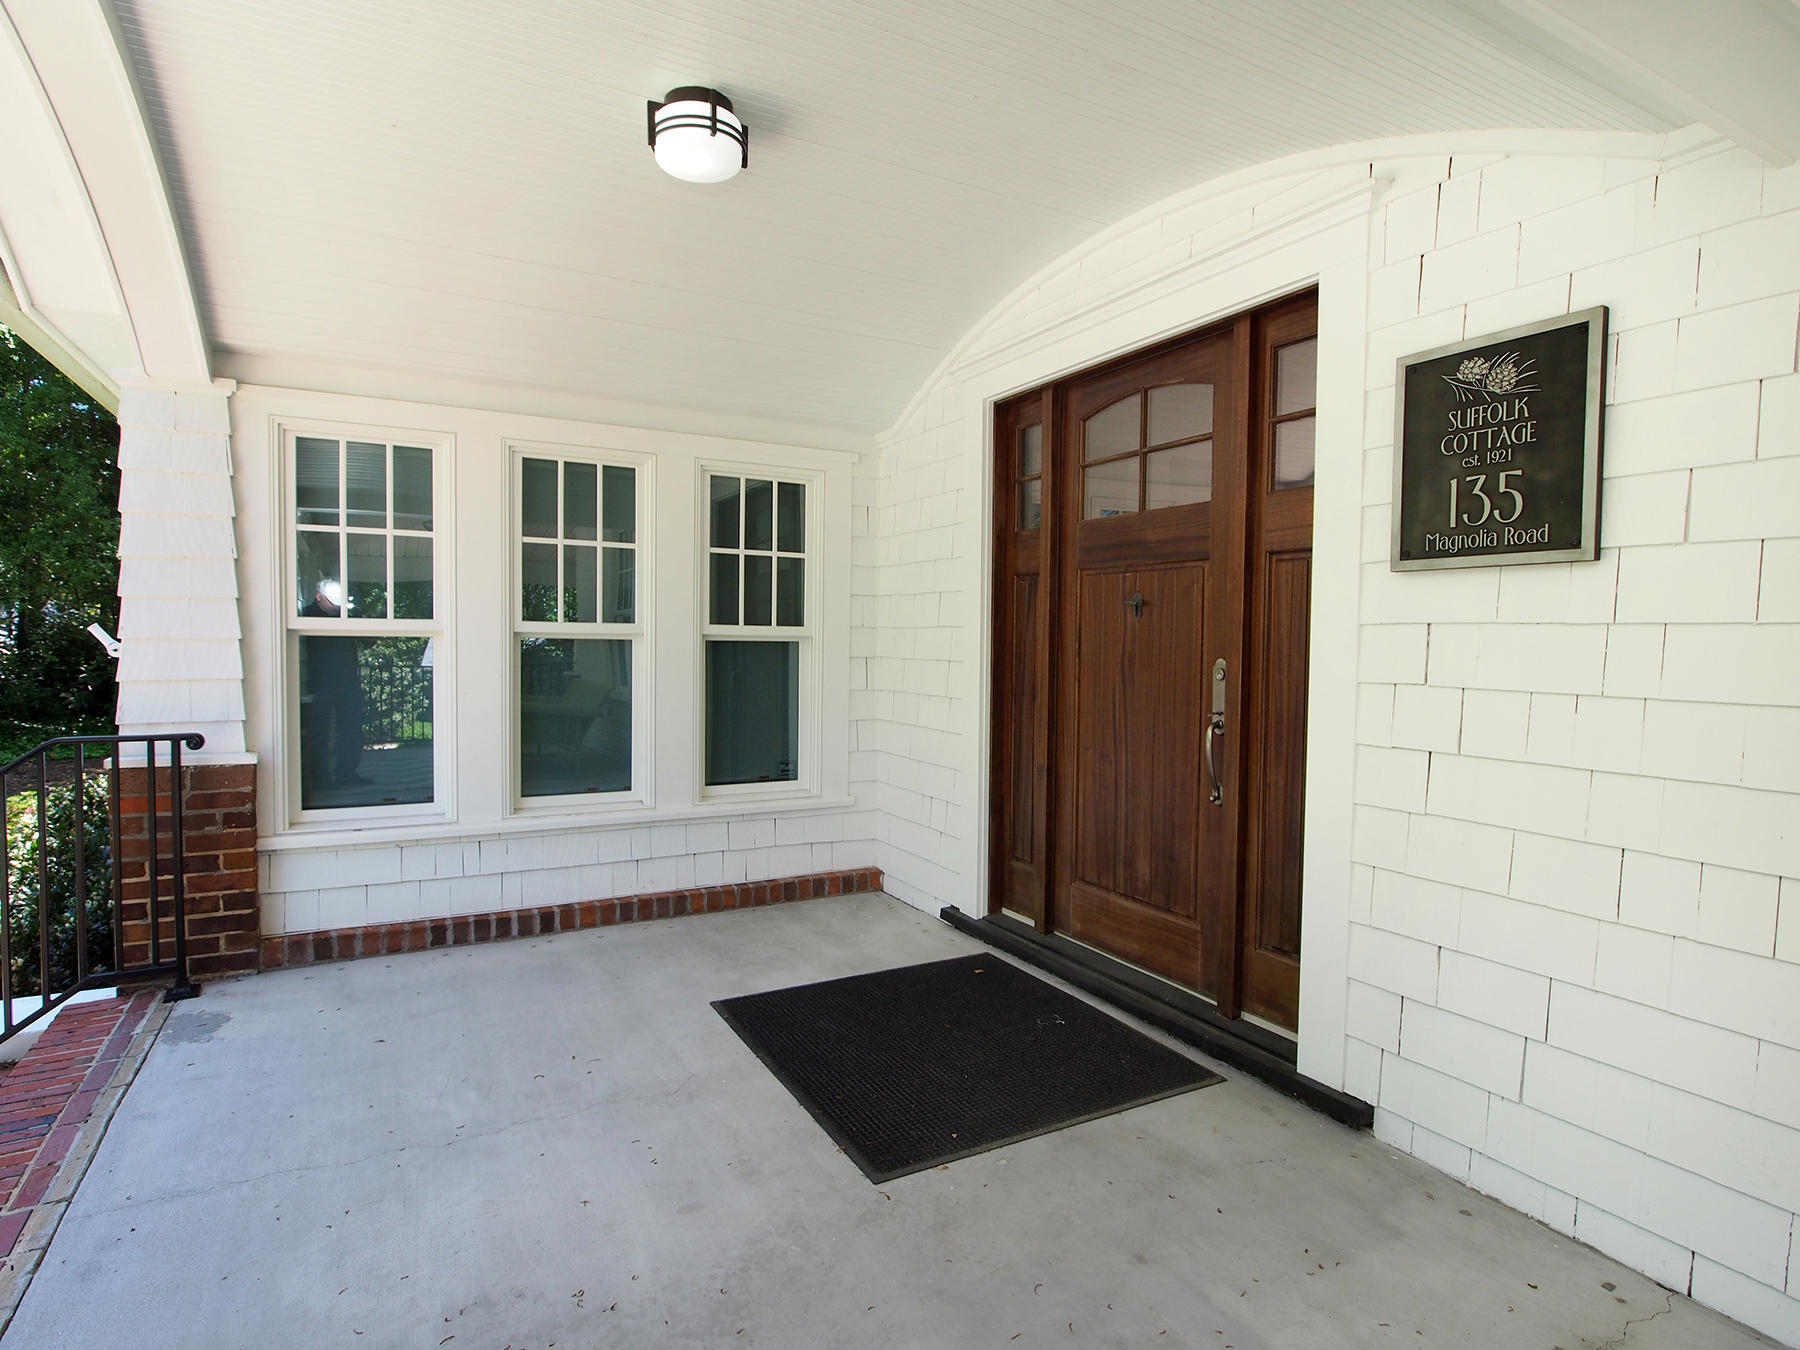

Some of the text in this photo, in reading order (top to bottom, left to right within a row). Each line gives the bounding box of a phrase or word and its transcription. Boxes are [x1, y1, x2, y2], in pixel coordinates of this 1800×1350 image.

[1448, 397, 1530, 432] SUFFOLK
[1441, 420, 1537, 455] COTTAGE
[1462, 448, 1512, 468] est. 1921
[1449, 469, 1524, 528] 135
[1426, 523, 1549, 553] Magnolia Road
